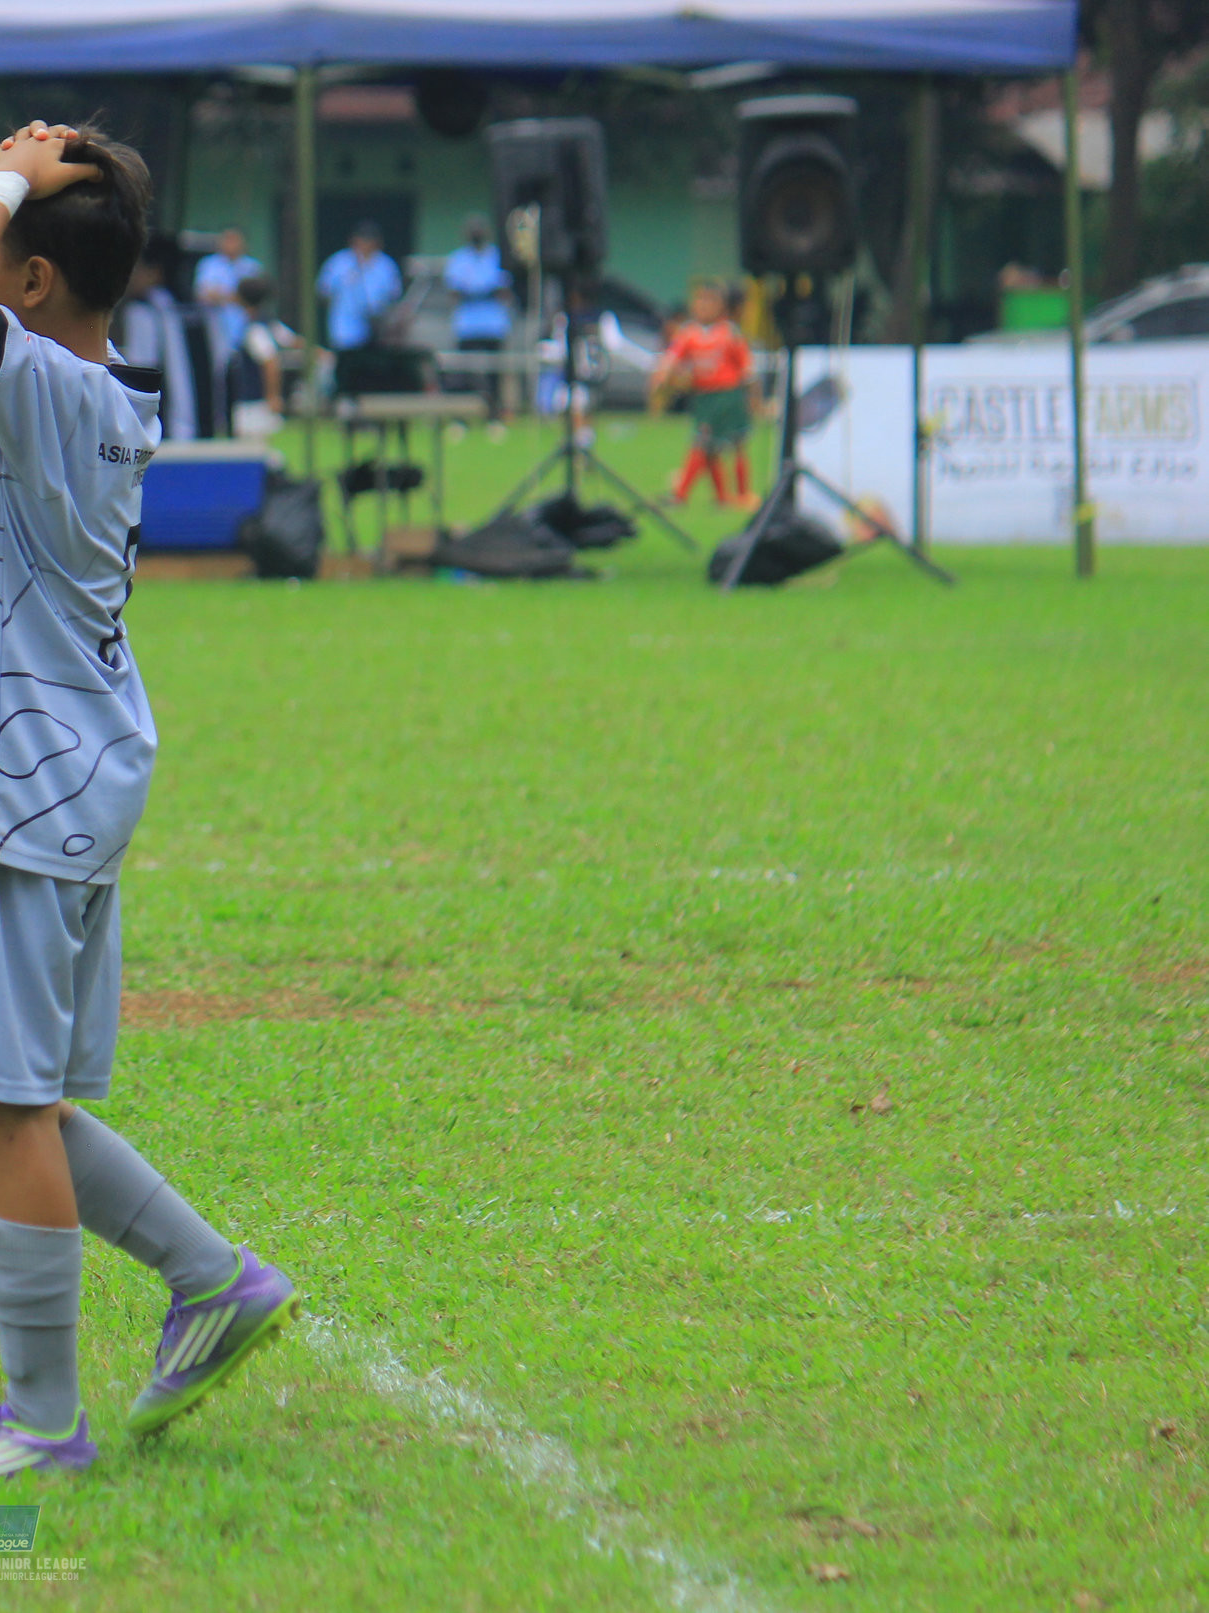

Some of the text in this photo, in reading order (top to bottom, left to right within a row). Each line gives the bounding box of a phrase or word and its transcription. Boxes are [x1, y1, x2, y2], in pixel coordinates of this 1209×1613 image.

[937, 383, 1191, 439] CASTLE ARMS
[97, 442, 132, 466] ASIA
